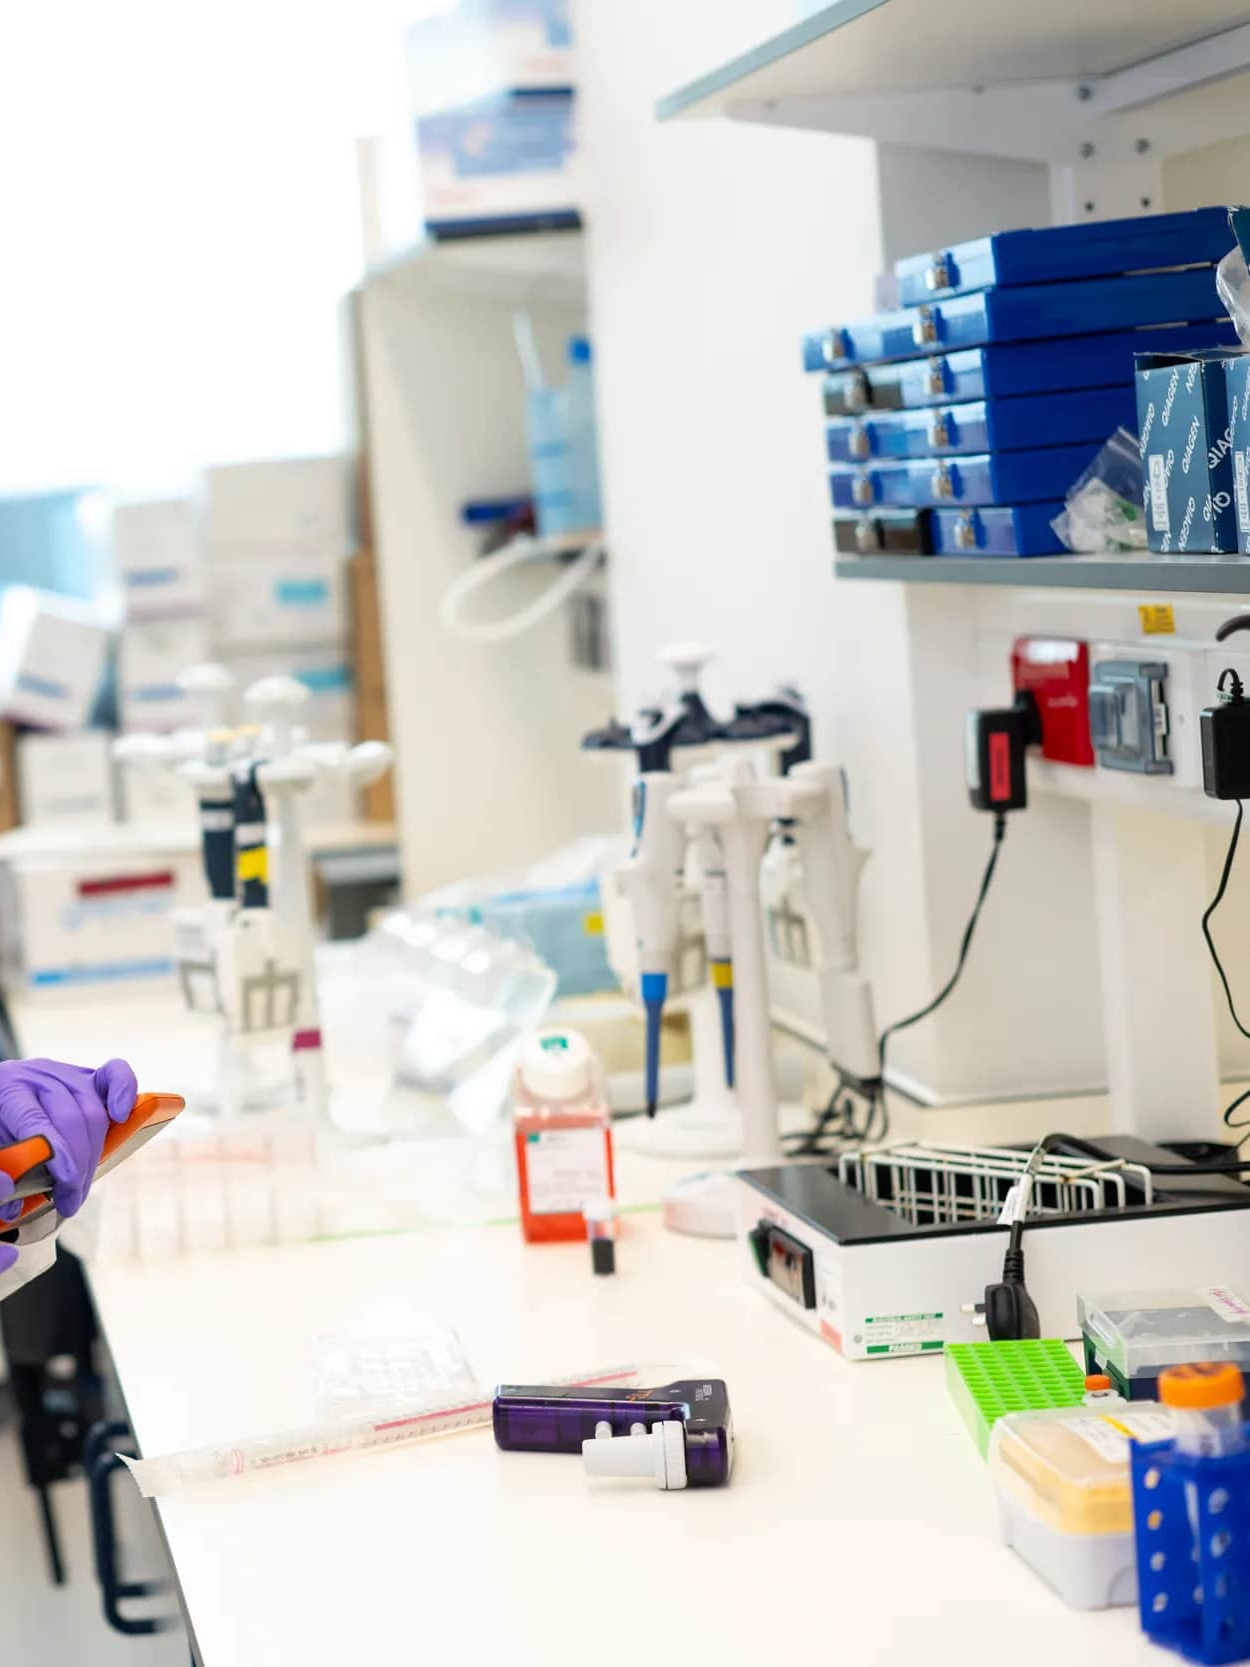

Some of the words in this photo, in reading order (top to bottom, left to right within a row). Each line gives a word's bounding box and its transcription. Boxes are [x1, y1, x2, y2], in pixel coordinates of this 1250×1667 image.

[1161, 368, 1179, 427] QIAGEN
[1182, 415, 1200, 474] QIAGEN
[1178, 496, 1195, 552] QIAGEN
